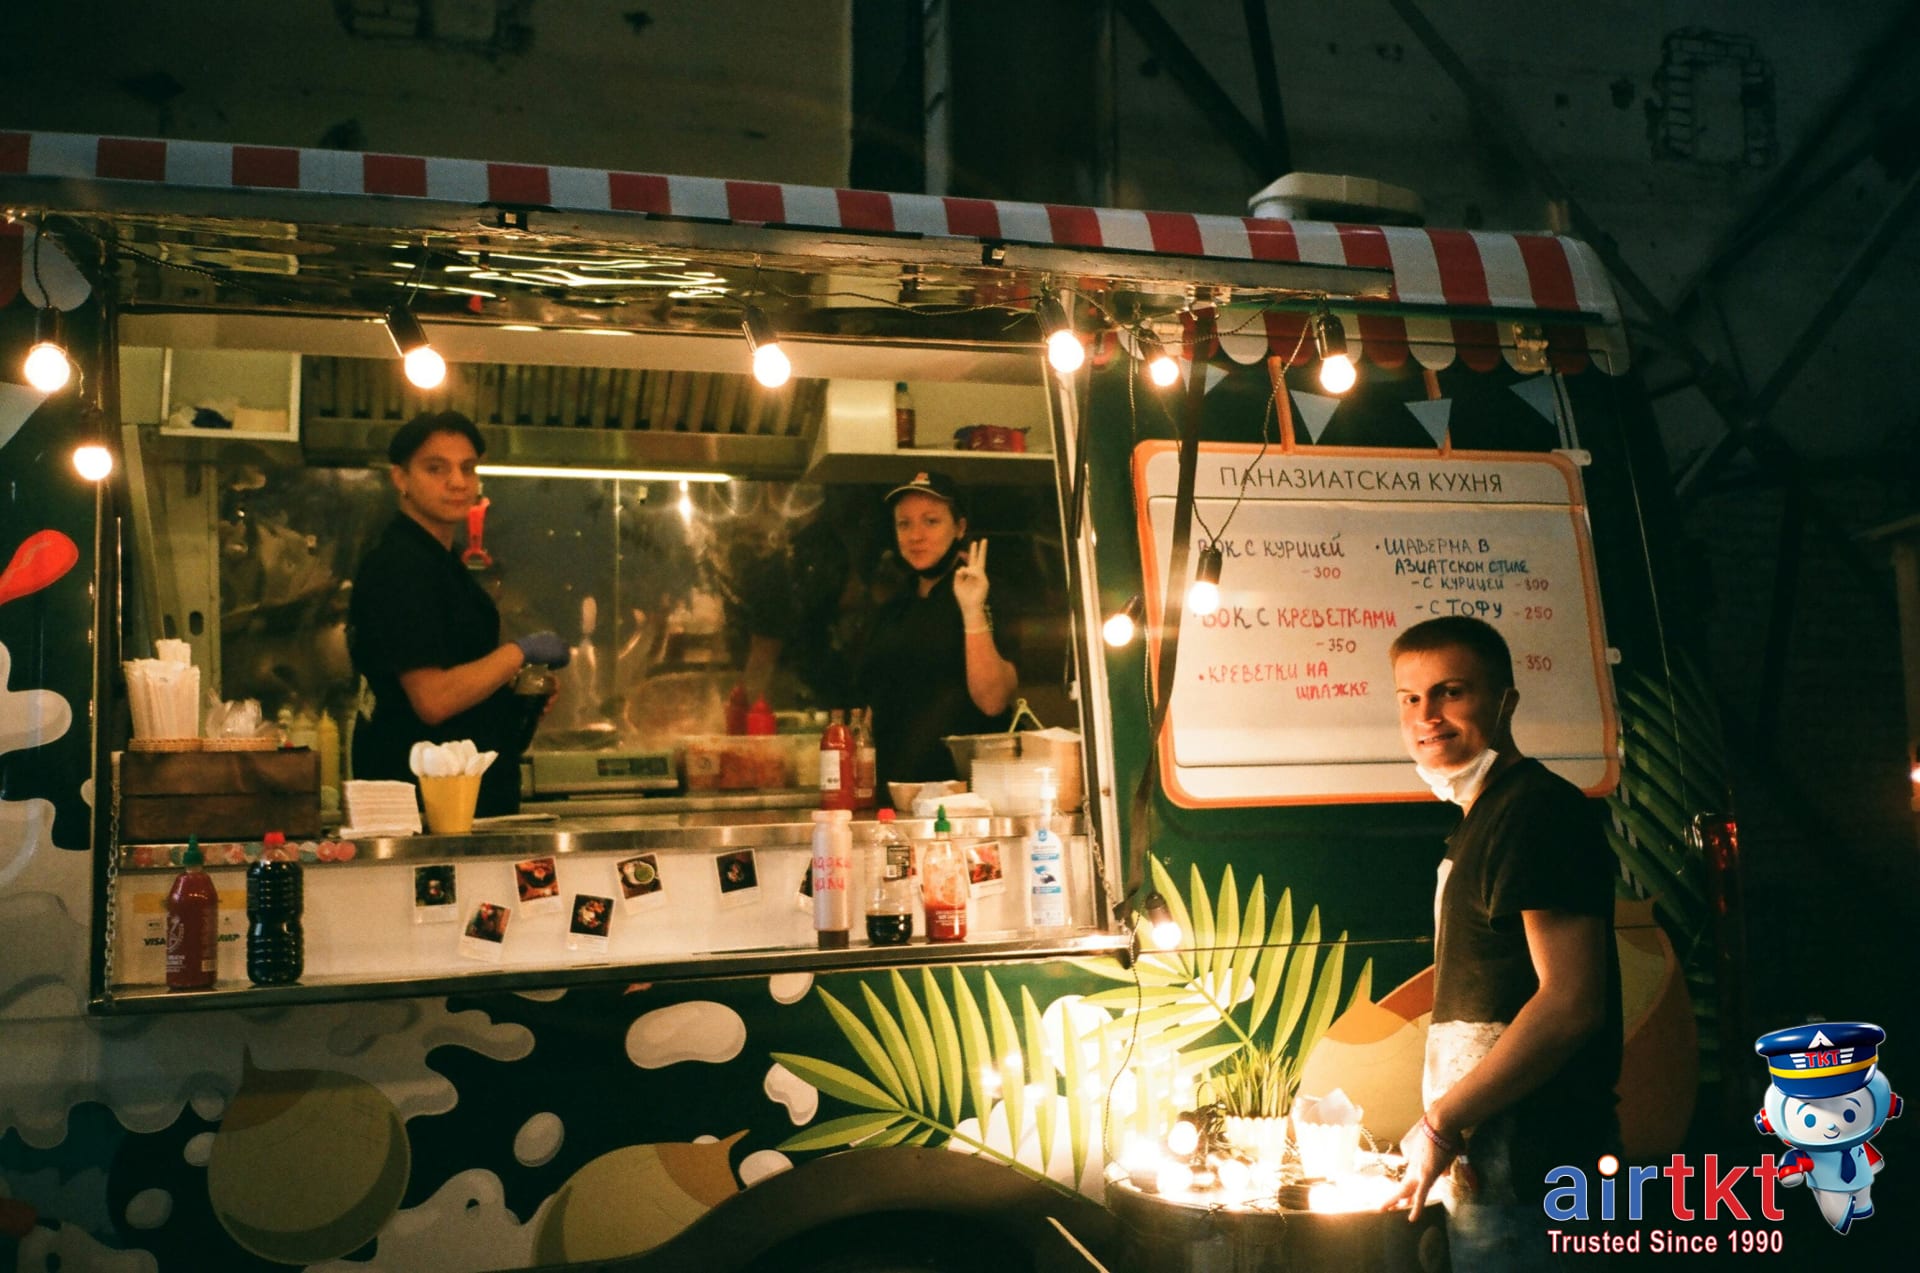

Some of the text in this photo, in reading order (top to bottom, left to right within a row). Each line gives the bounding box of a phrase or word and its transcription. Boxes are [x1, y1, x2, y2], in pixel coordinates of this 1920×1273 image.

[1220, 467, 1502, 492] ПАНАЗИАТСКАЯ КУХНЯ
[1245, 539, 1255, 556] С
[1264, 532, 1344, 558] КУРИЦЕЙ
[1479, 538, 1490, 553] В
[1395, 558, 1529, 575] АЗИАТСКОМ СТИЛЕ
[1257, 607, 1270, 626] С
[1277, 607, 1397, 628] КРЕВЕТКАМИ
[1446, 599, 1502, 618] ТОФУ
[1209, 660, 1328, 684] КРЕВЕТКИ НА
[1296, 681, 1368, 700] ШПАЖКЕ
[144, 937, 166, 946] VISA
